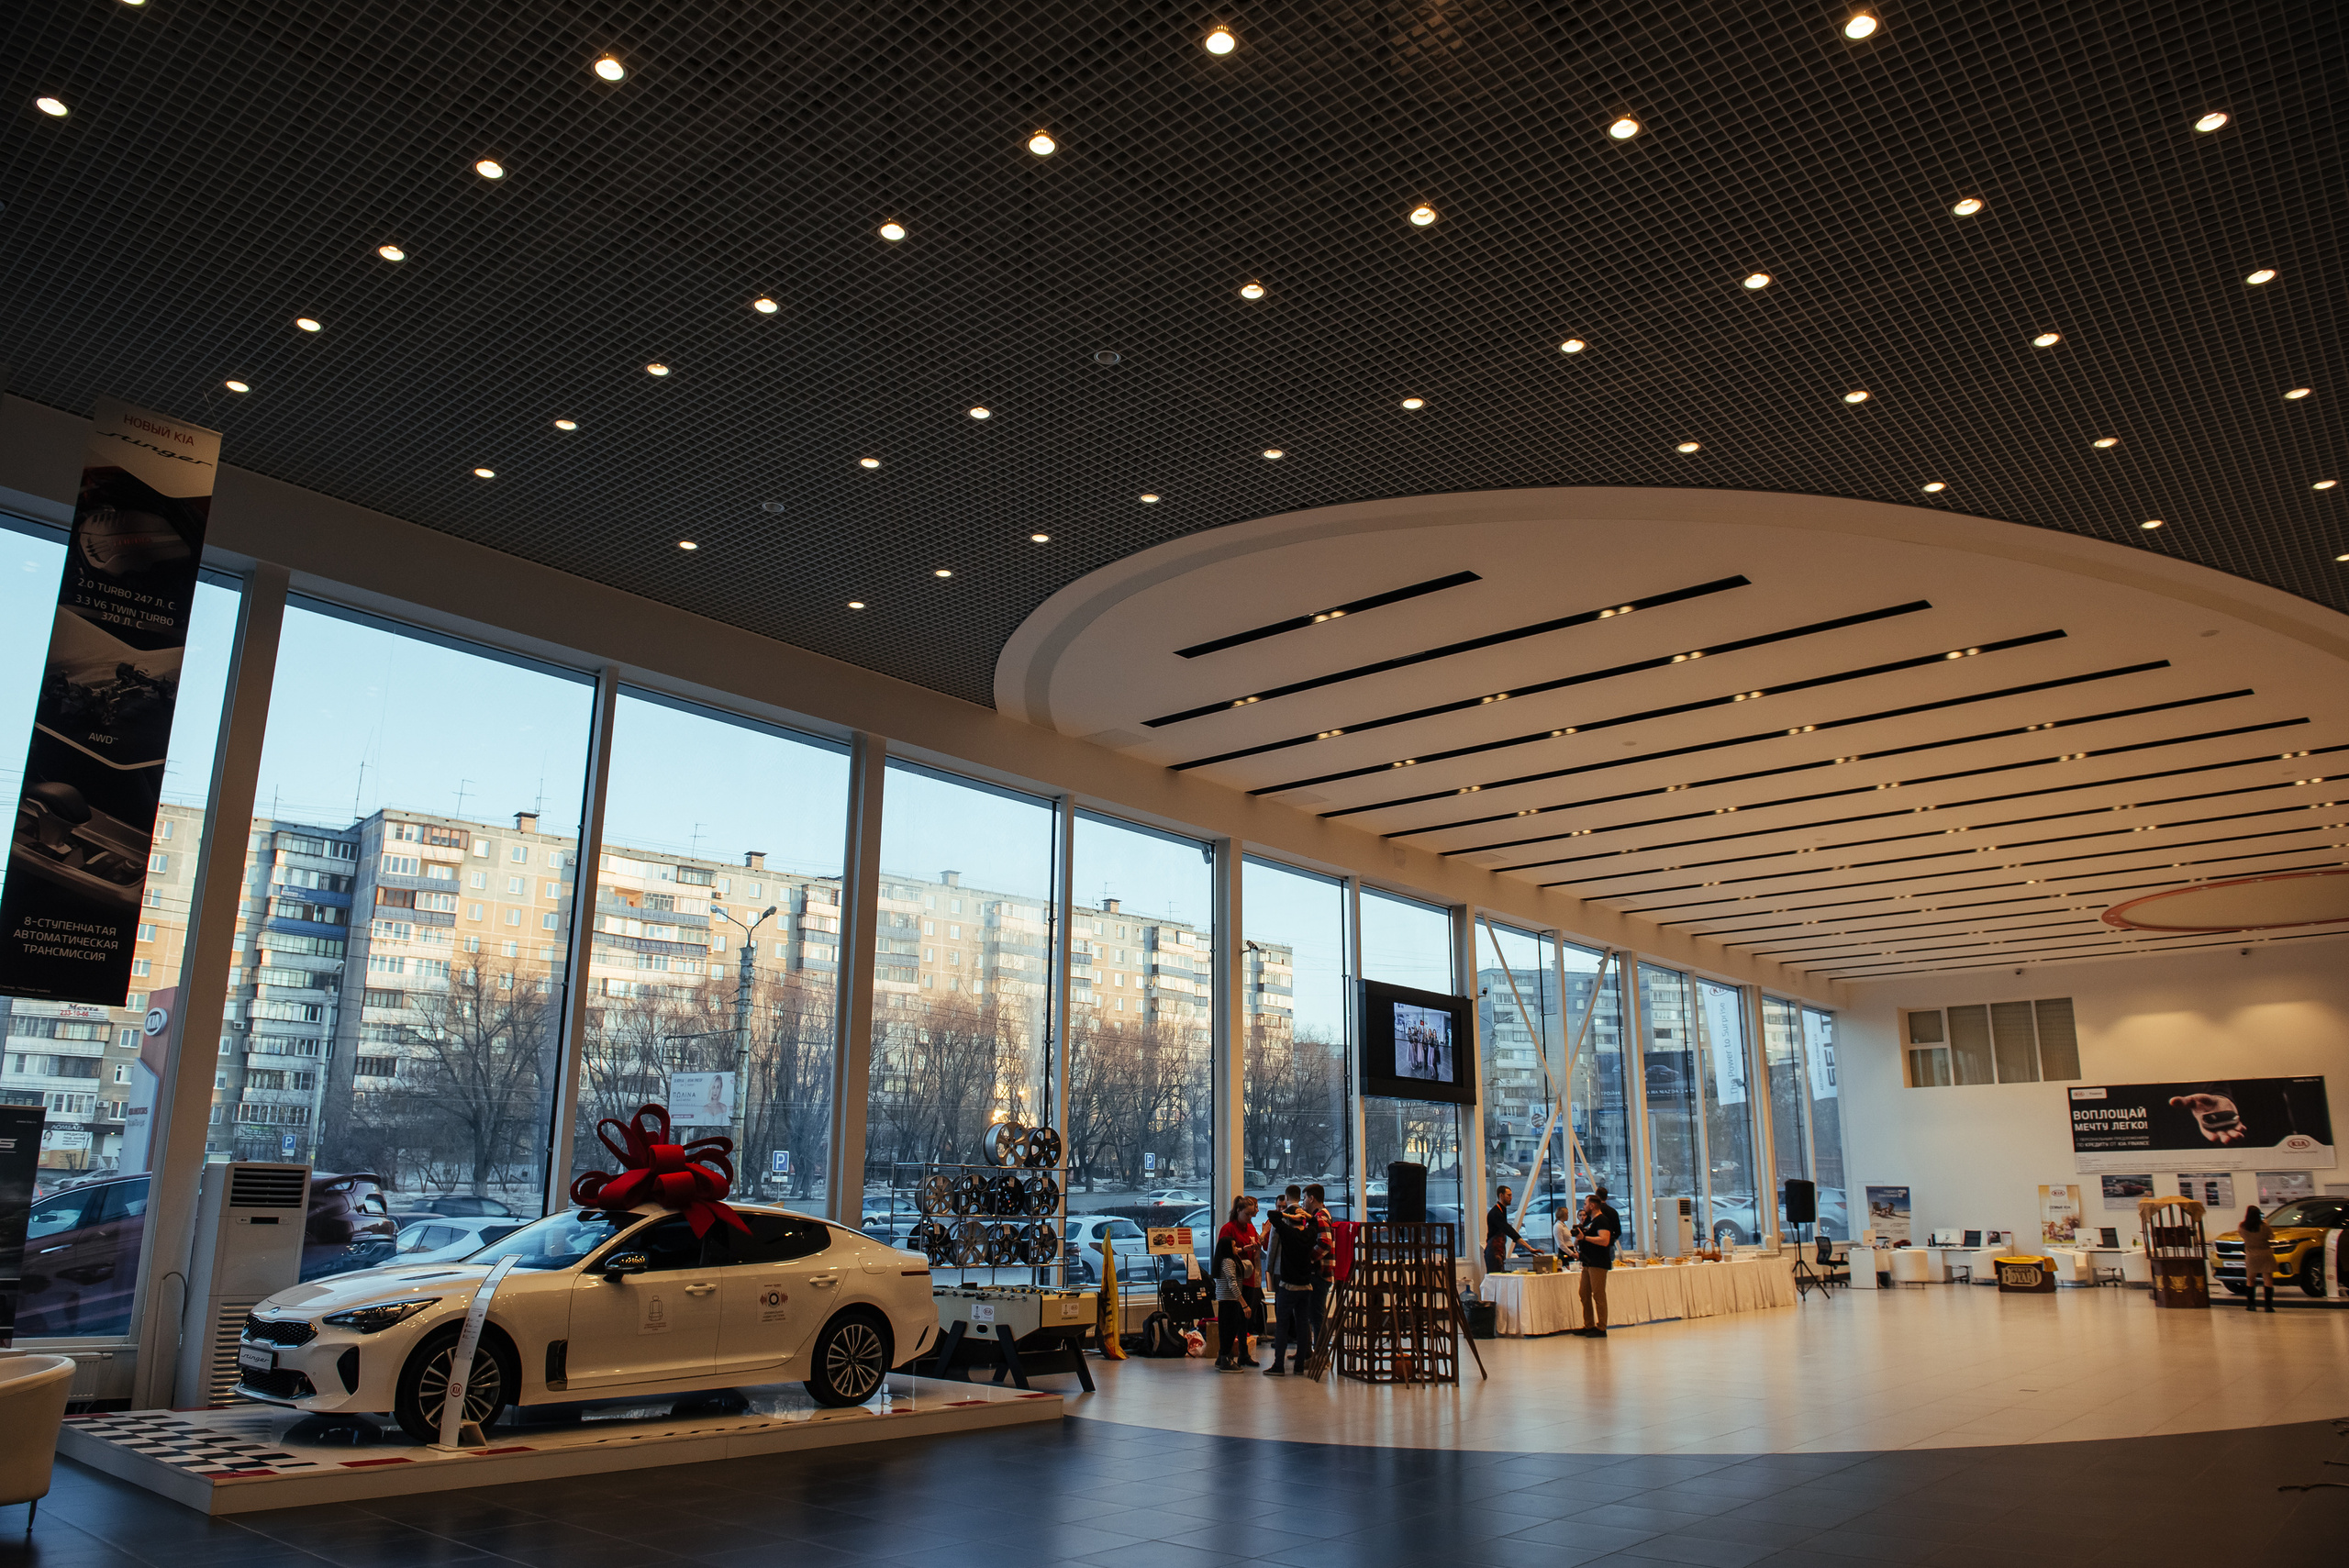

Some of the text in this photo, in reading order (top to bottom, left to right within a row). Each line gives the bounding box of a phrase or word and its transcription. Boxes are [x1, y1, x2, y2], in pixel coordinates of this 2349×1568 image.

[123, 414, 195, 446] НОВЫЙ KIA
[77, 577, 95, 589] 2.0
[97, 582, 132, 599] TURBO
[134, 593, 153, 604] 247
[75, 594, 174, 627] 3.3 V6 TWIN TURBO
[101, 611, 120, 623] 370
[24, 917, 117, 936] 8-СТУПЕНЧАТАЯ
[13, 929, 119, 950] АВТОМАТИЧЕСКАЯ
[22, 943, 106, 962] ТРАНСМИССИЯ
[1720, 1002, 1730, 1038] Surprise
[1724, 1039, 1731, 1048] to
[2073, 1106, 2147, 1120] ВОПЛОЩАЙ
[2075, 1120, 2149, 1131] МЕЧТУ ЛЕГКО!
